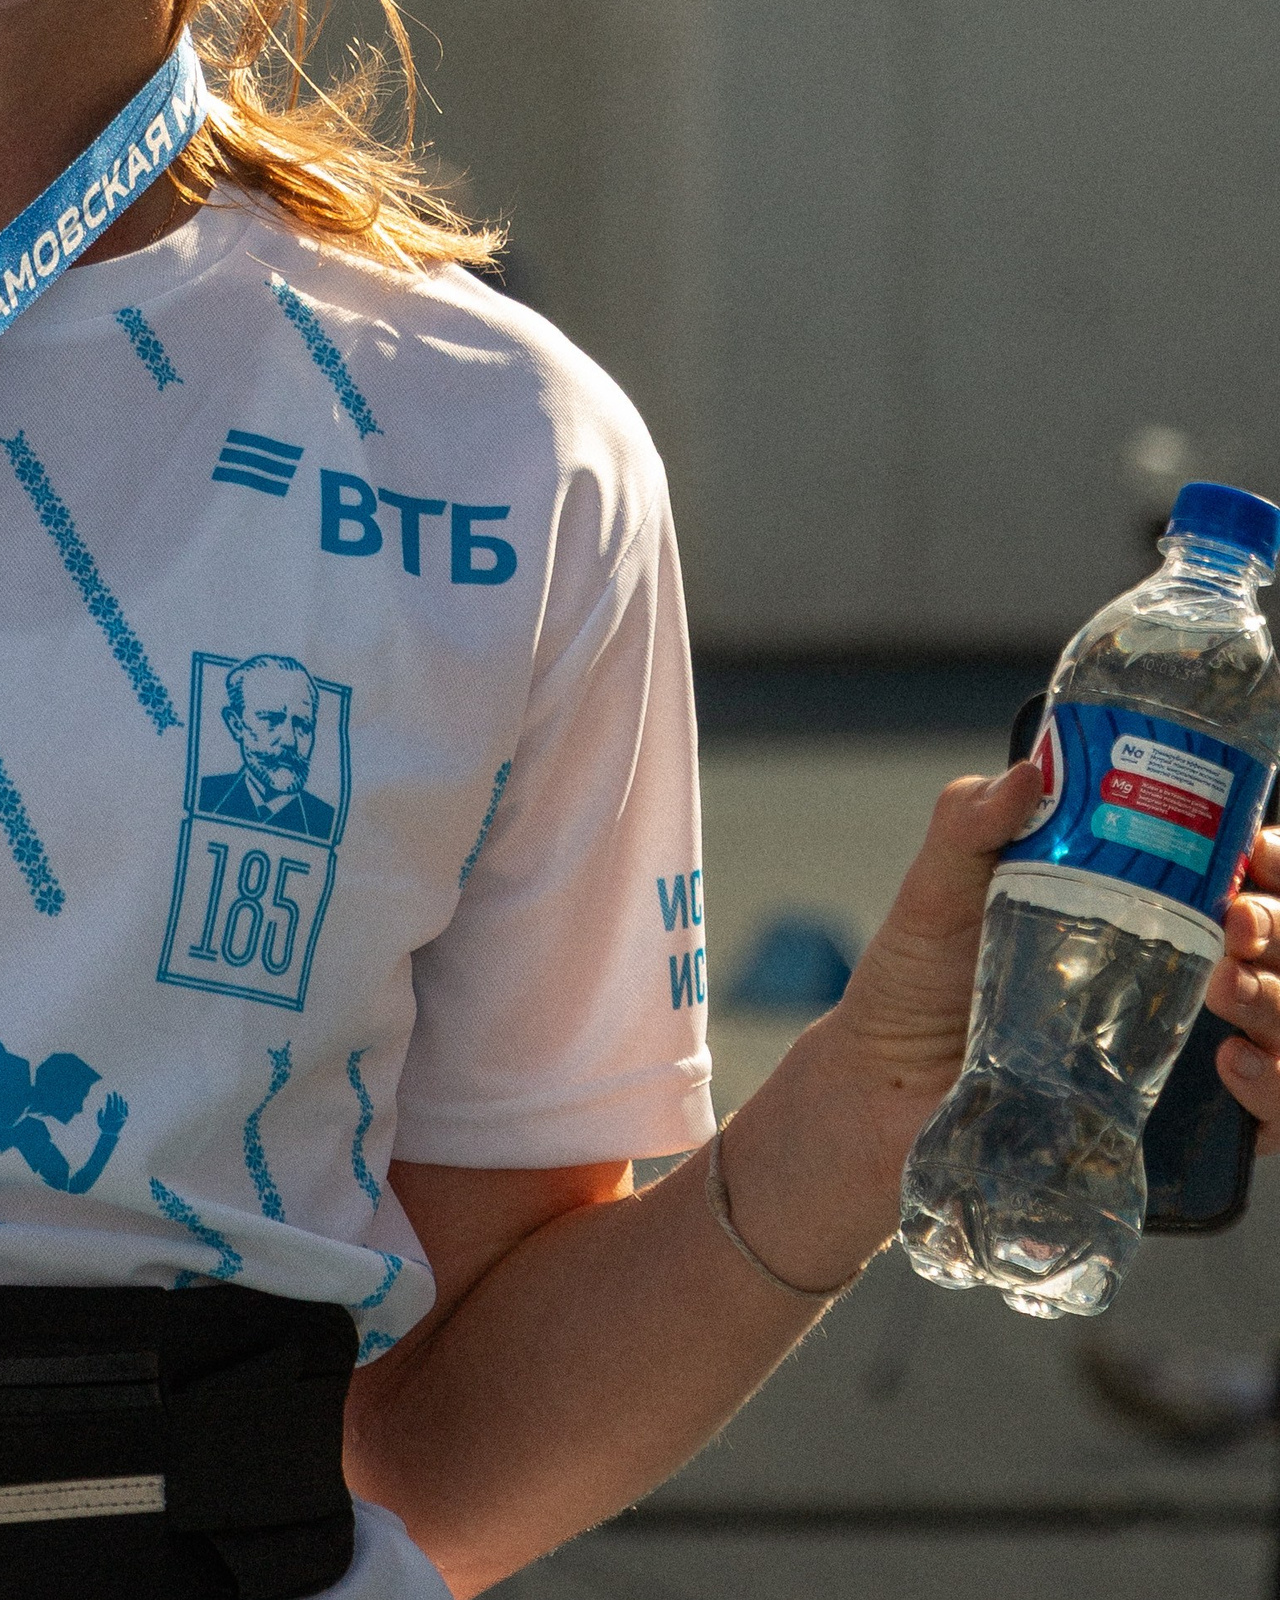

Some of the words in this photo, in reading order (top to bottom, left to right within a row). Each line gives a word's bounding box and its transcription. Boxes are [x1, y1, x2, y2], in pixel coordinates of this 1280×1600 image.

[320, 468, 518, 586] ВТБ
[1121, 743, 1145, 759] Na
[1111, 778, 1133, 794] Mg
[187, 840, 312, 977] 185
